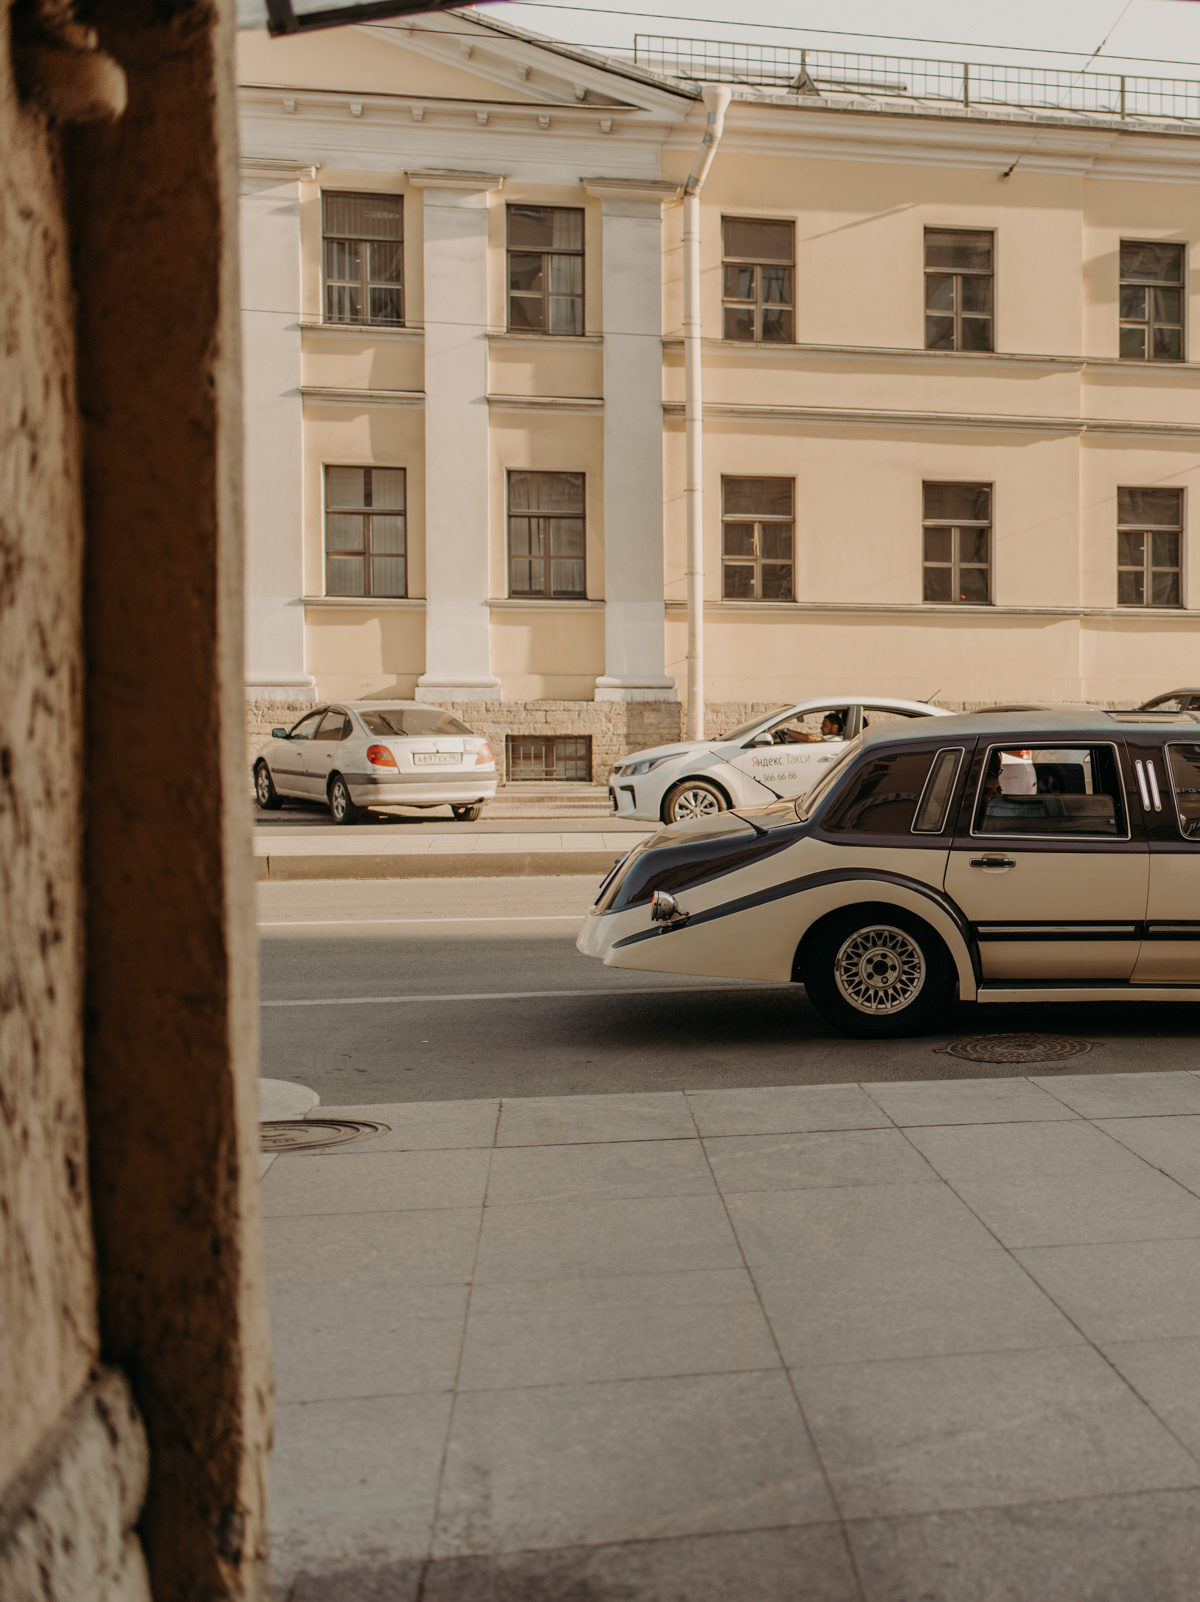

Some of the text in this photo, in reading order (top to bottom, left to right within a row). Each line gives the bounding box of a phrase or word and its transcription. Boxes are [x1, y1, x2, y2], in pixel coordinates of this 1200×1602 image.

[752, 754, 810, 767] Яндекс Такси
[763, 773, 776, 782] 366
[778, 772, 787, 780] 66
